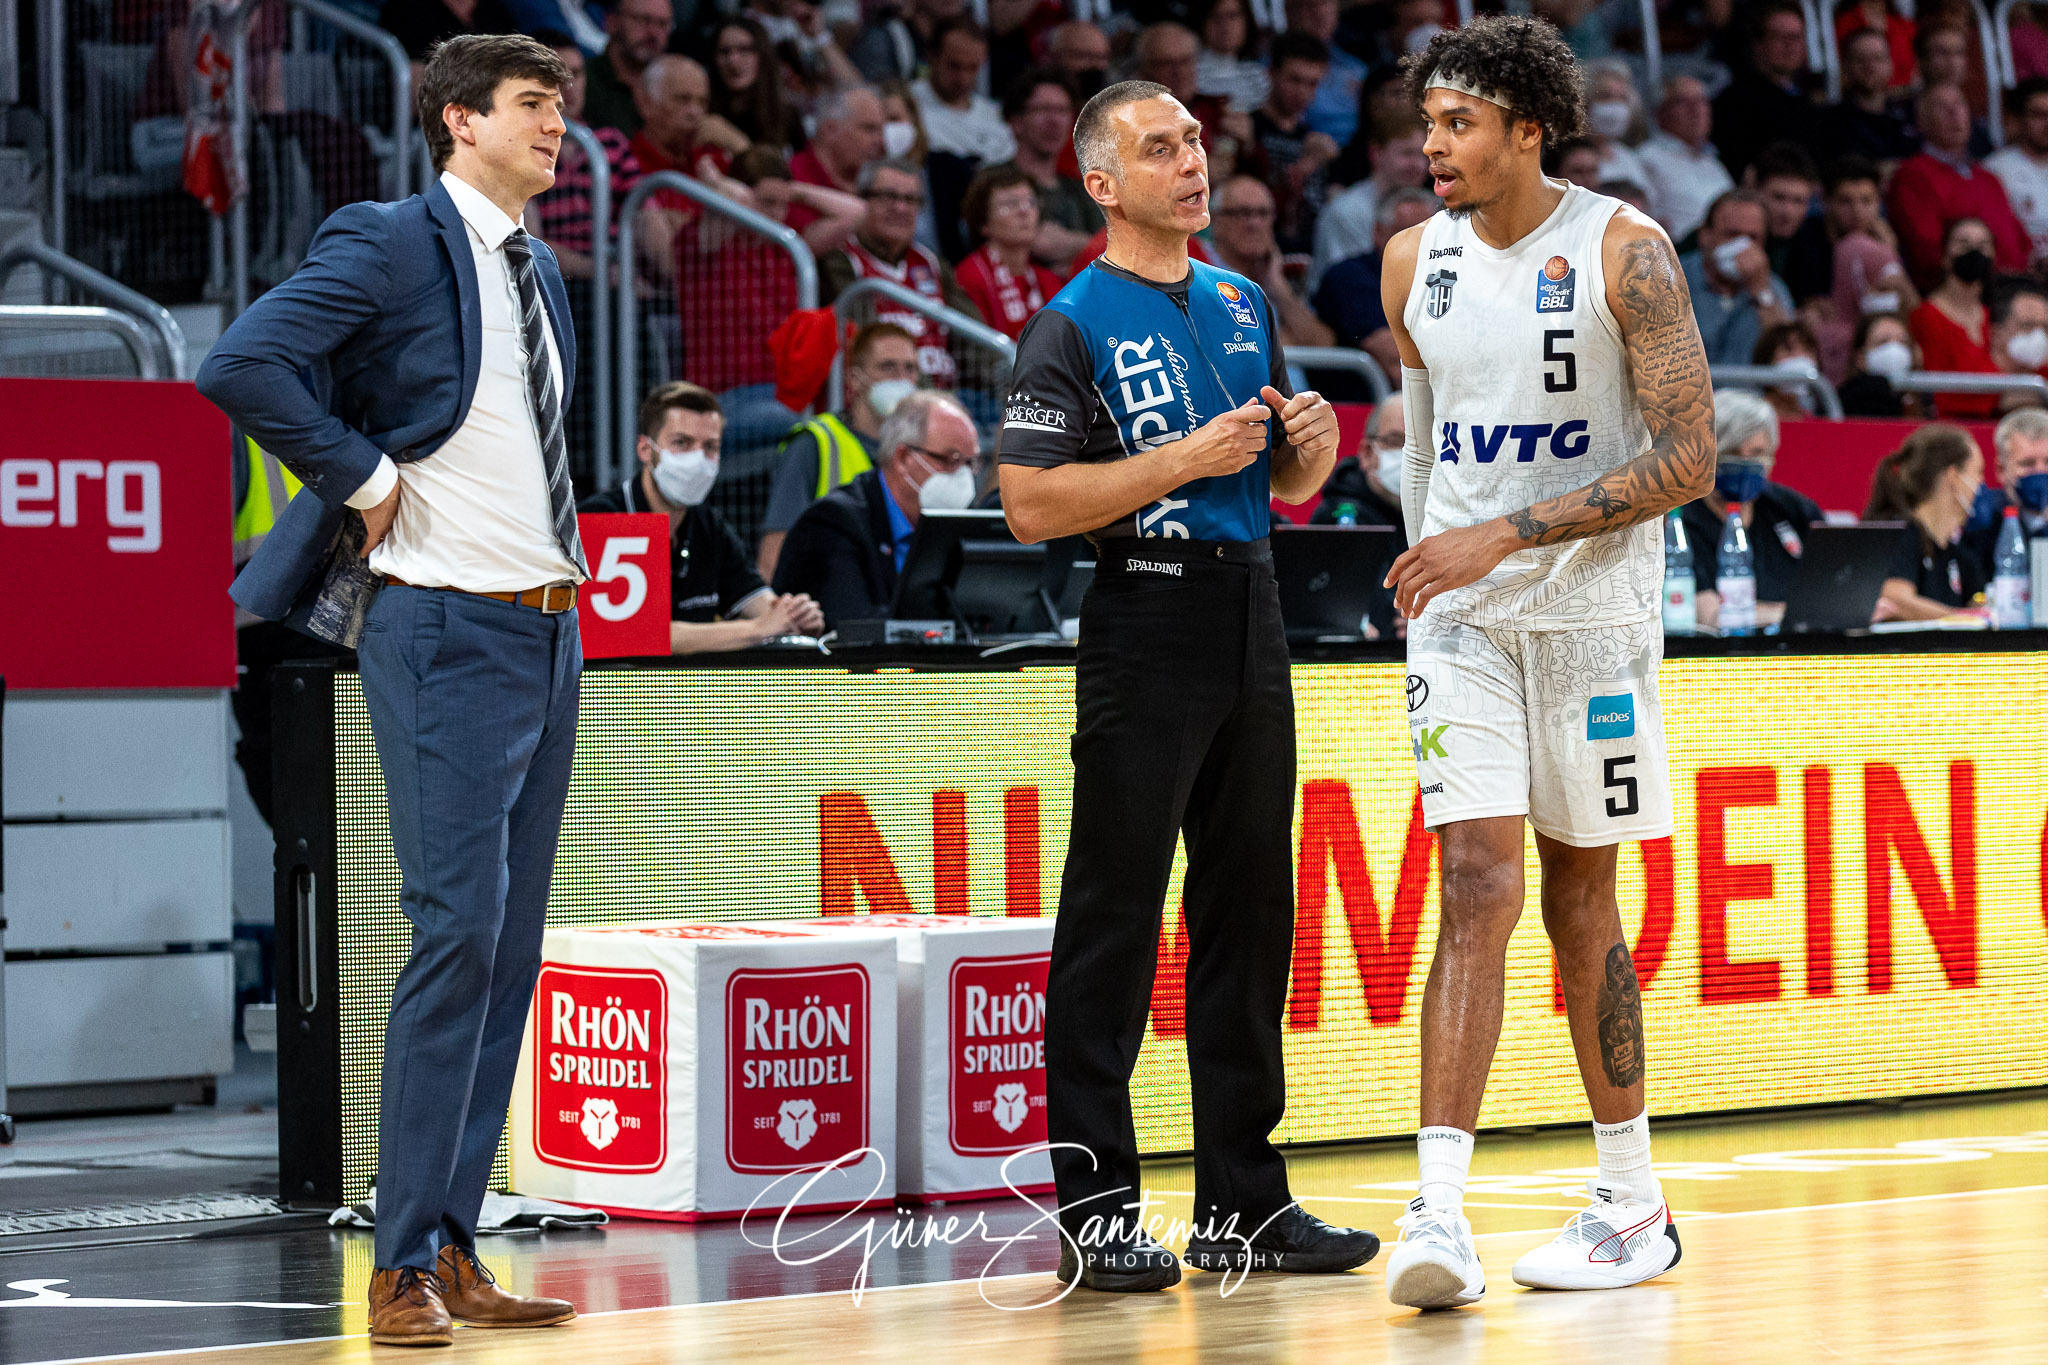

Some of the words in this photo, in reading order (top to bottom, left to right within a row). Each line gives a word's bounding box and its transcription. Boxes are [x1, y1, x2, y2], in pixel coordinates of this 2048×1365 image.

[1539, 296, 1569, 309] BBL
[1235, 312, 1256, 325] BBL
[1222, 340, 1260, 355] SPALDING
[1543, 329, 1577, 393] 5
[1470, 419, 1591, 463] VTG
[0, 458, 163, 553] erg
[1126, 558, 1183, 577] SPALDING
[590, 536, 650, 622] 5
[1591, 711, 1631, 724] LinkDes
[1603, 754, 1639, 818] 5
[549, 1051, 653, 1090] SPRUDEL
[742, 1054, 853, 1089] SPRUDEL
[972, 1099, 992, 1113] SEIT
[558, 1109, 580, 1124] SEIT
[620, 1115, 641, 1130] 1781
[753, 1115, 776, 1129] SEIT
[820, 1111, 841, 1125] 1781
